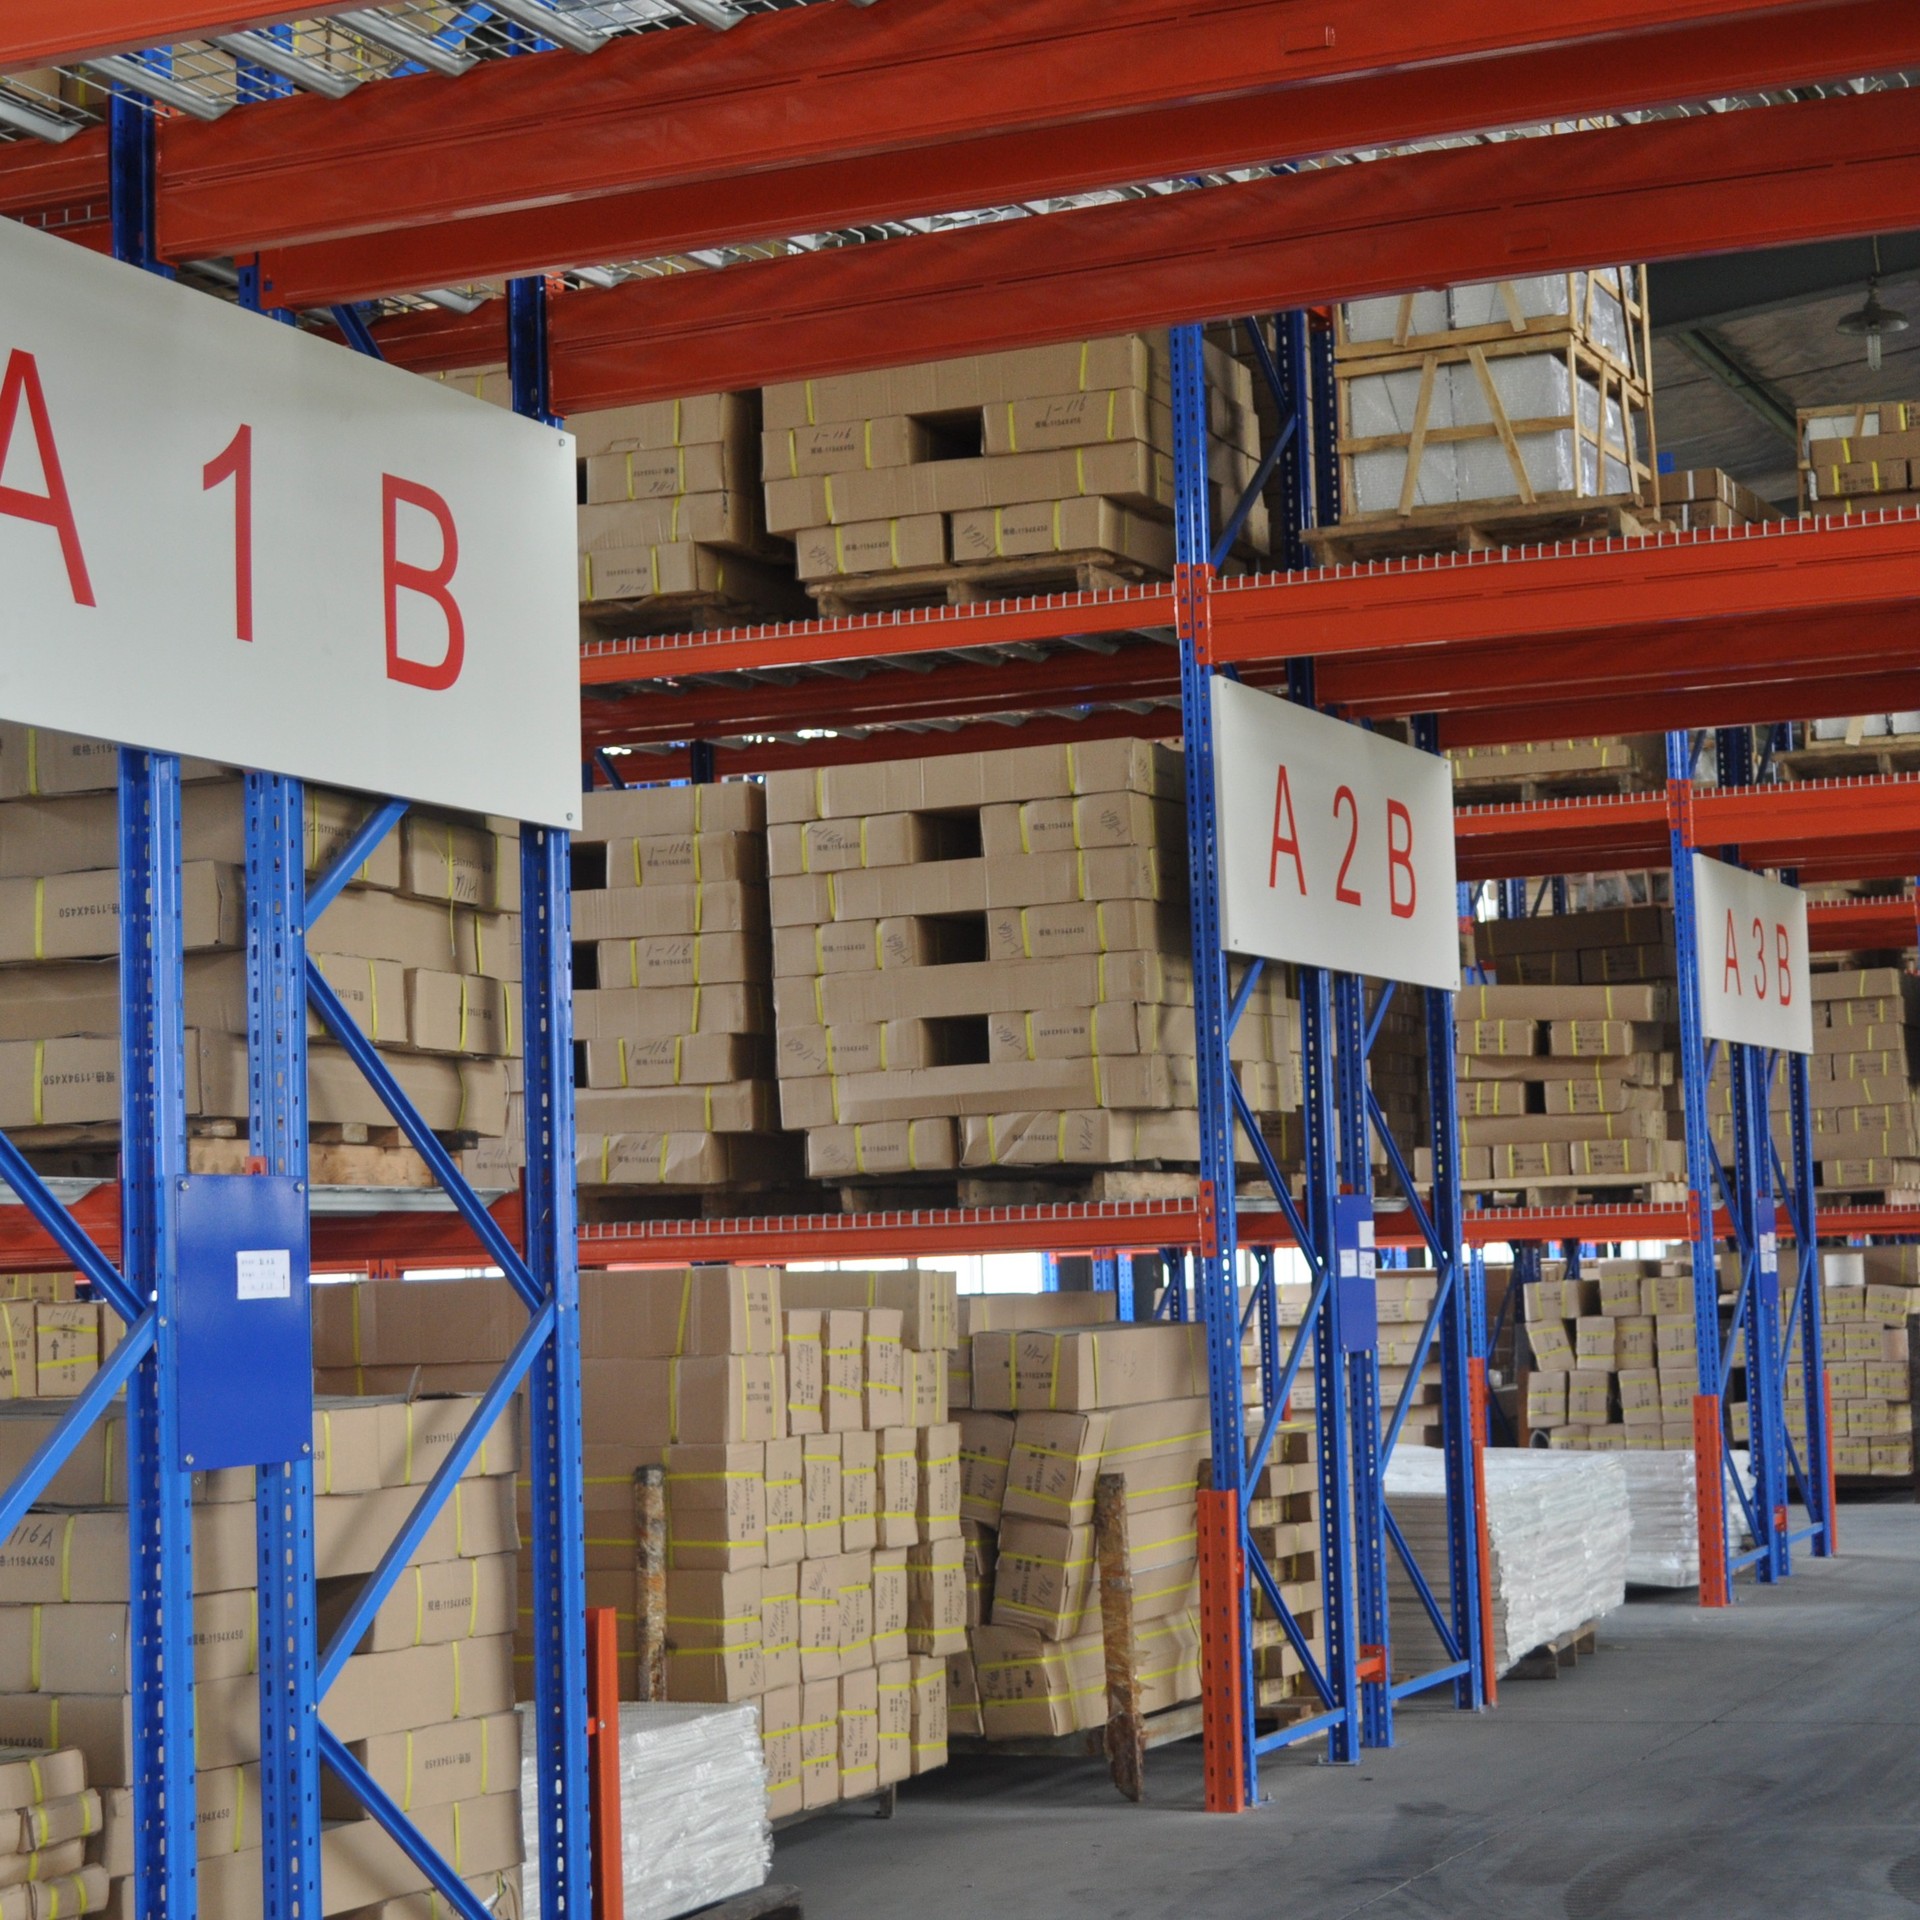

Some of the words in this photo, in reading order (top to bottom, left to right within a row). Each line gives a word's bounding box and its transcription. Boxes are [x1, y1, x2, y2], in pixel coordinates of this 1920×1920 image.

[0, 348, 97, 607] A
[203, 423, 253, 642] 1
[382, 472, 465, 691] B
[1269, 764, 1307, 896] A
[1333, 785, 1361, 906] 2
[1387, 798, 1416, 919] B
[1724, 908, 1741, 996] A
[1753, 918, 1766, 1000] 3
[1776, 923, 1791, 1006] B
